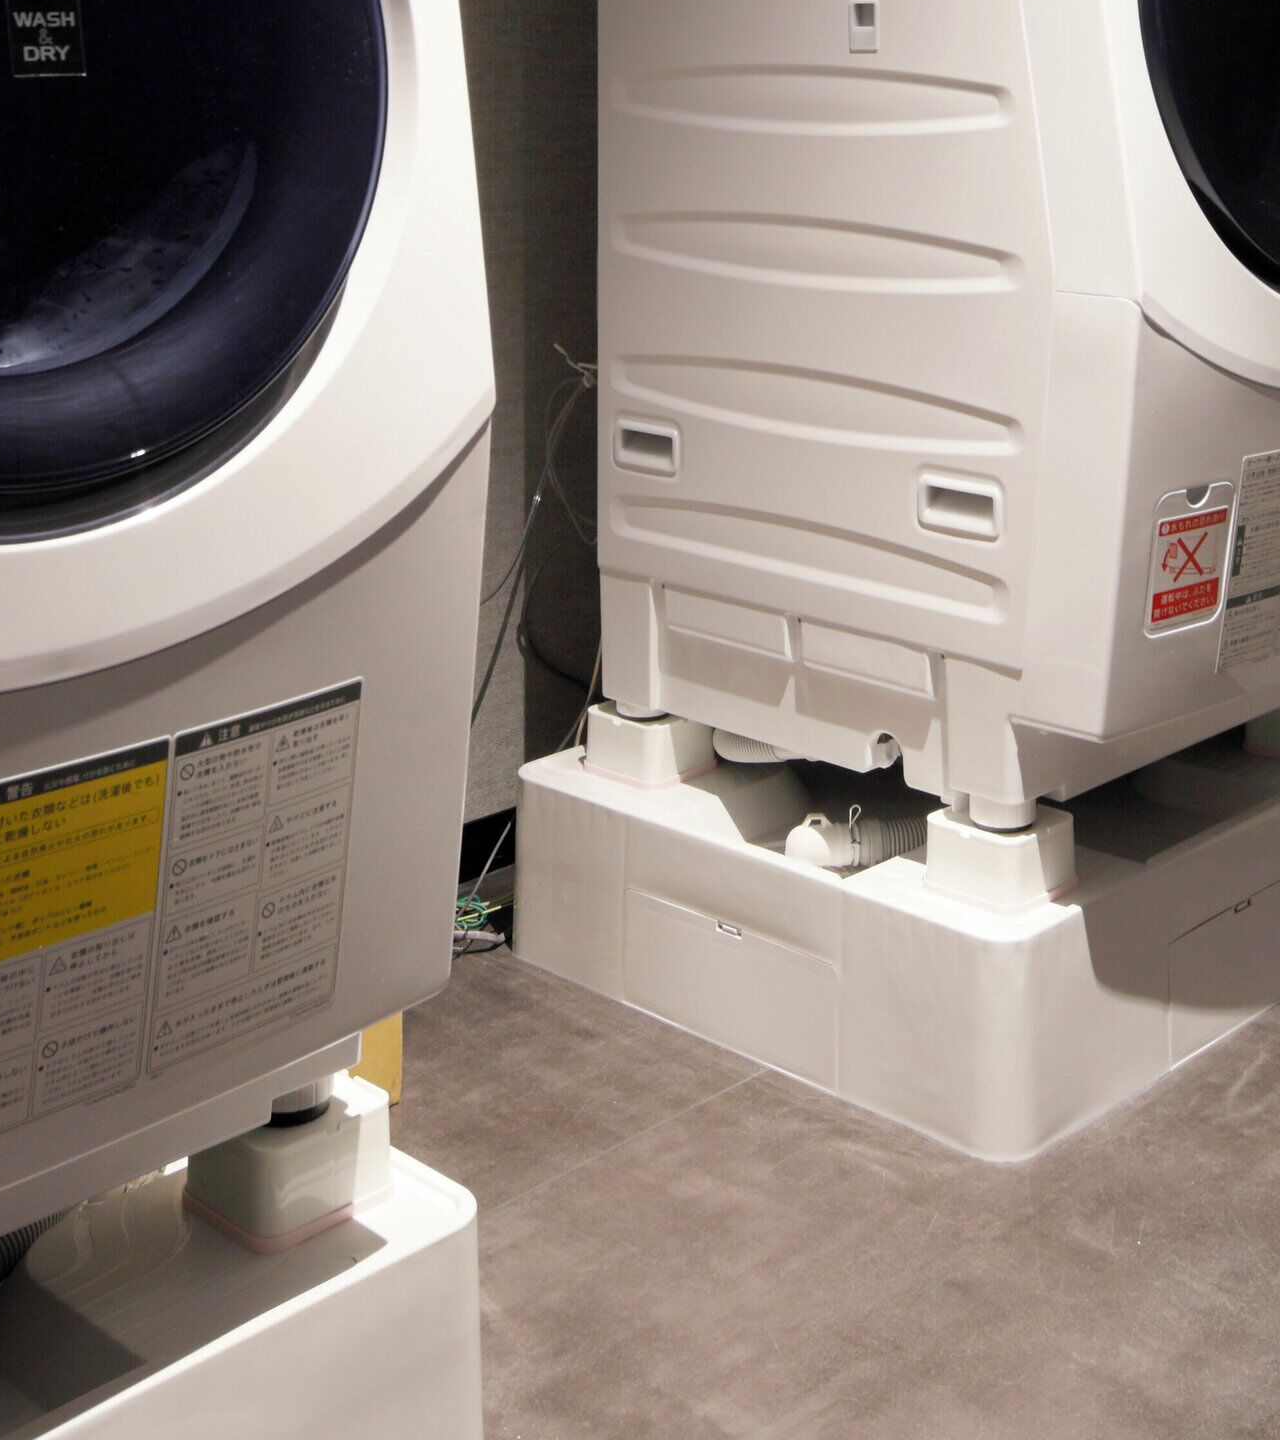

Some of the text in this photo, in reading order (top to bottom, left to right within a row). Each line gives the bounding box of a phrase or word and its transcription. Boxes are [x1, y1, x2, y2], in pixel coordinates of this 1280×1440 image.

[12, 11, 76, 28] WASH
[39, 27, 54, 46] &
[23, 44, 72, 62] DRY
[217, 722, 241, 742] 注意
[6, 781, 32, 801] 警告
[286, 799, 337, 824] やけどに注意する
